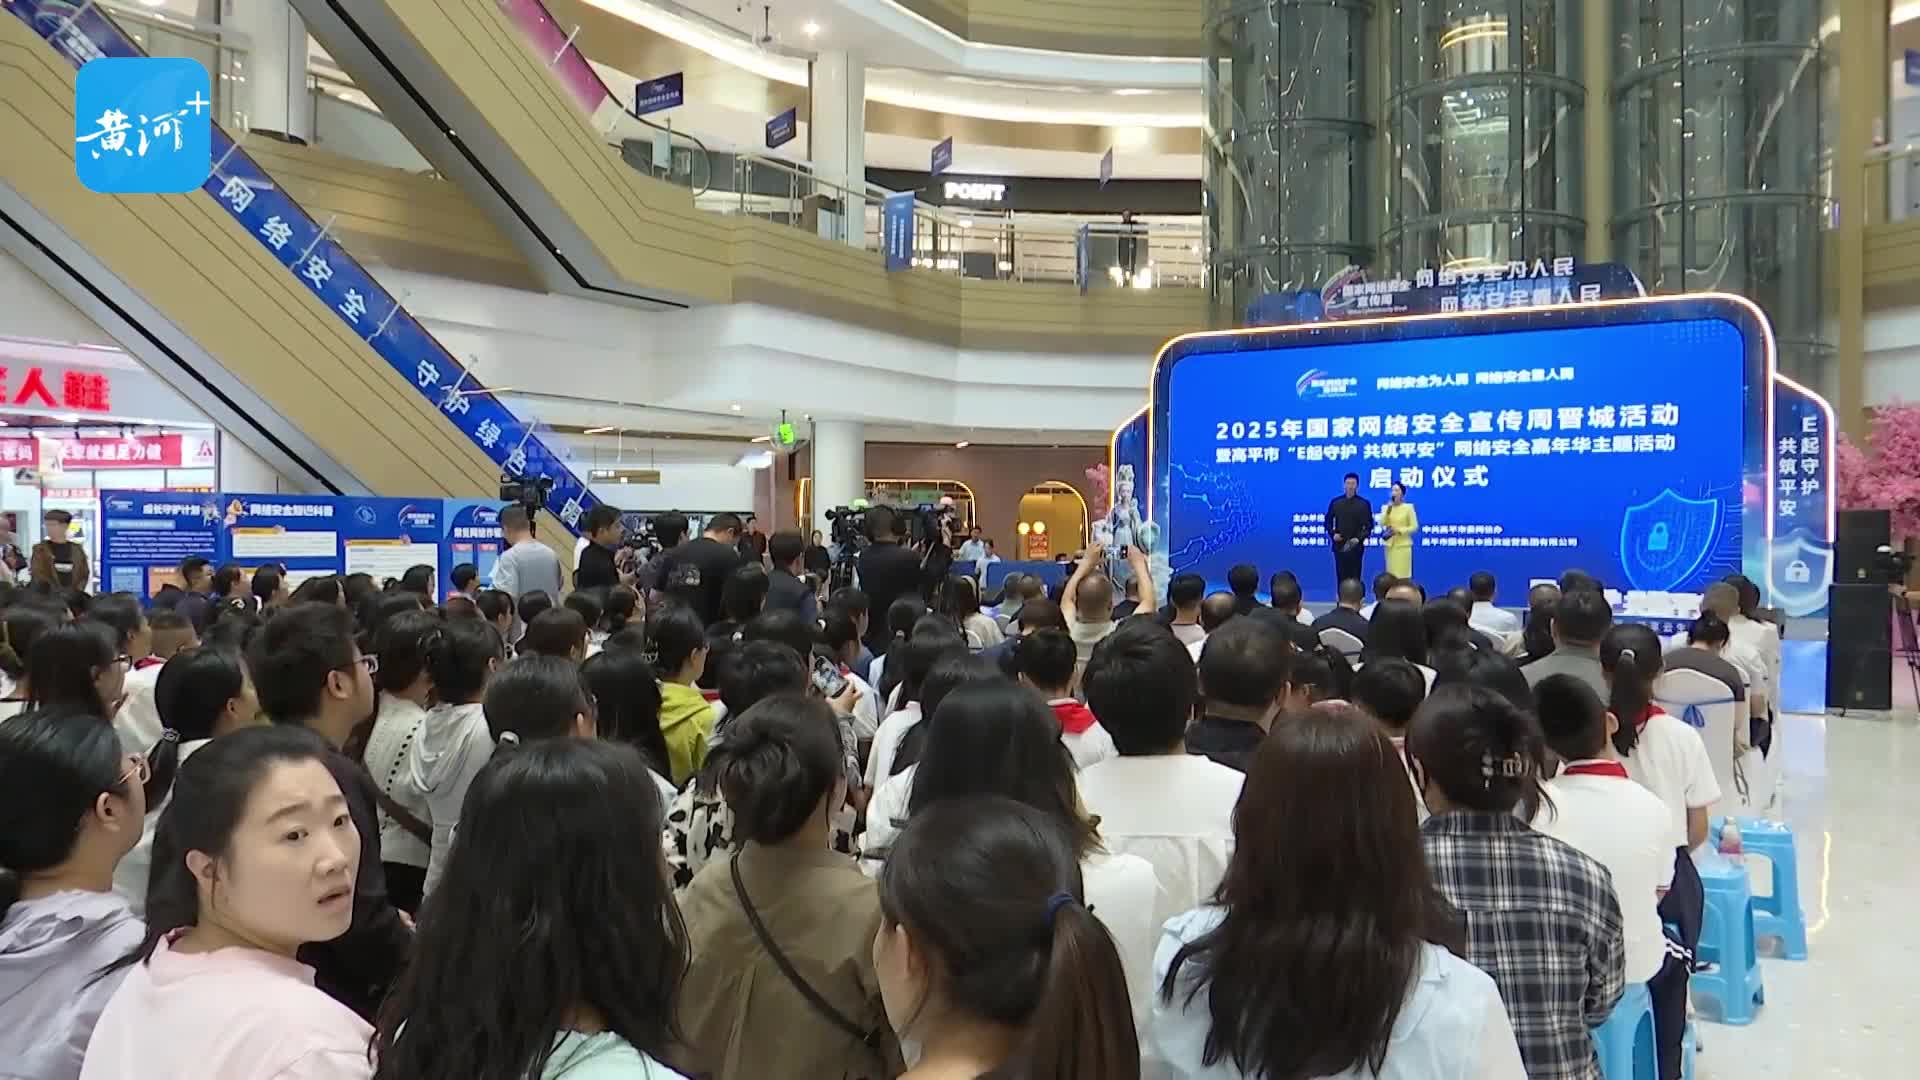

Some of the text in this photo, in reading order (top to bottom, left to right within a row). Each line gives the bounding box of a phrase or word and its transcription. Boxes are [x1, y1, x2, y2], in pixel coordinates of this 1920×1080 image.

[945, 181, 1005, 200] POINT
[220, 176, 367, 324] 网络安全
[1416, 257, 1574, 288] 网络安全为人民
[1376, 372, 1469, 391] 网络安全为人民
[1216, 402, 1680, 440] 2025年国家网络安全宣传周晋城活动
[1215, 446, 1280, 463] 暨高平市
[1454, 433, 1676, 457] 网络安全嘉年华主题活动
[1800, 416, 1820, 496] E起守护
[1369, 465, 1490, 489] 启动仪式
[1779, 437, 1797, 517] 共筑平安
